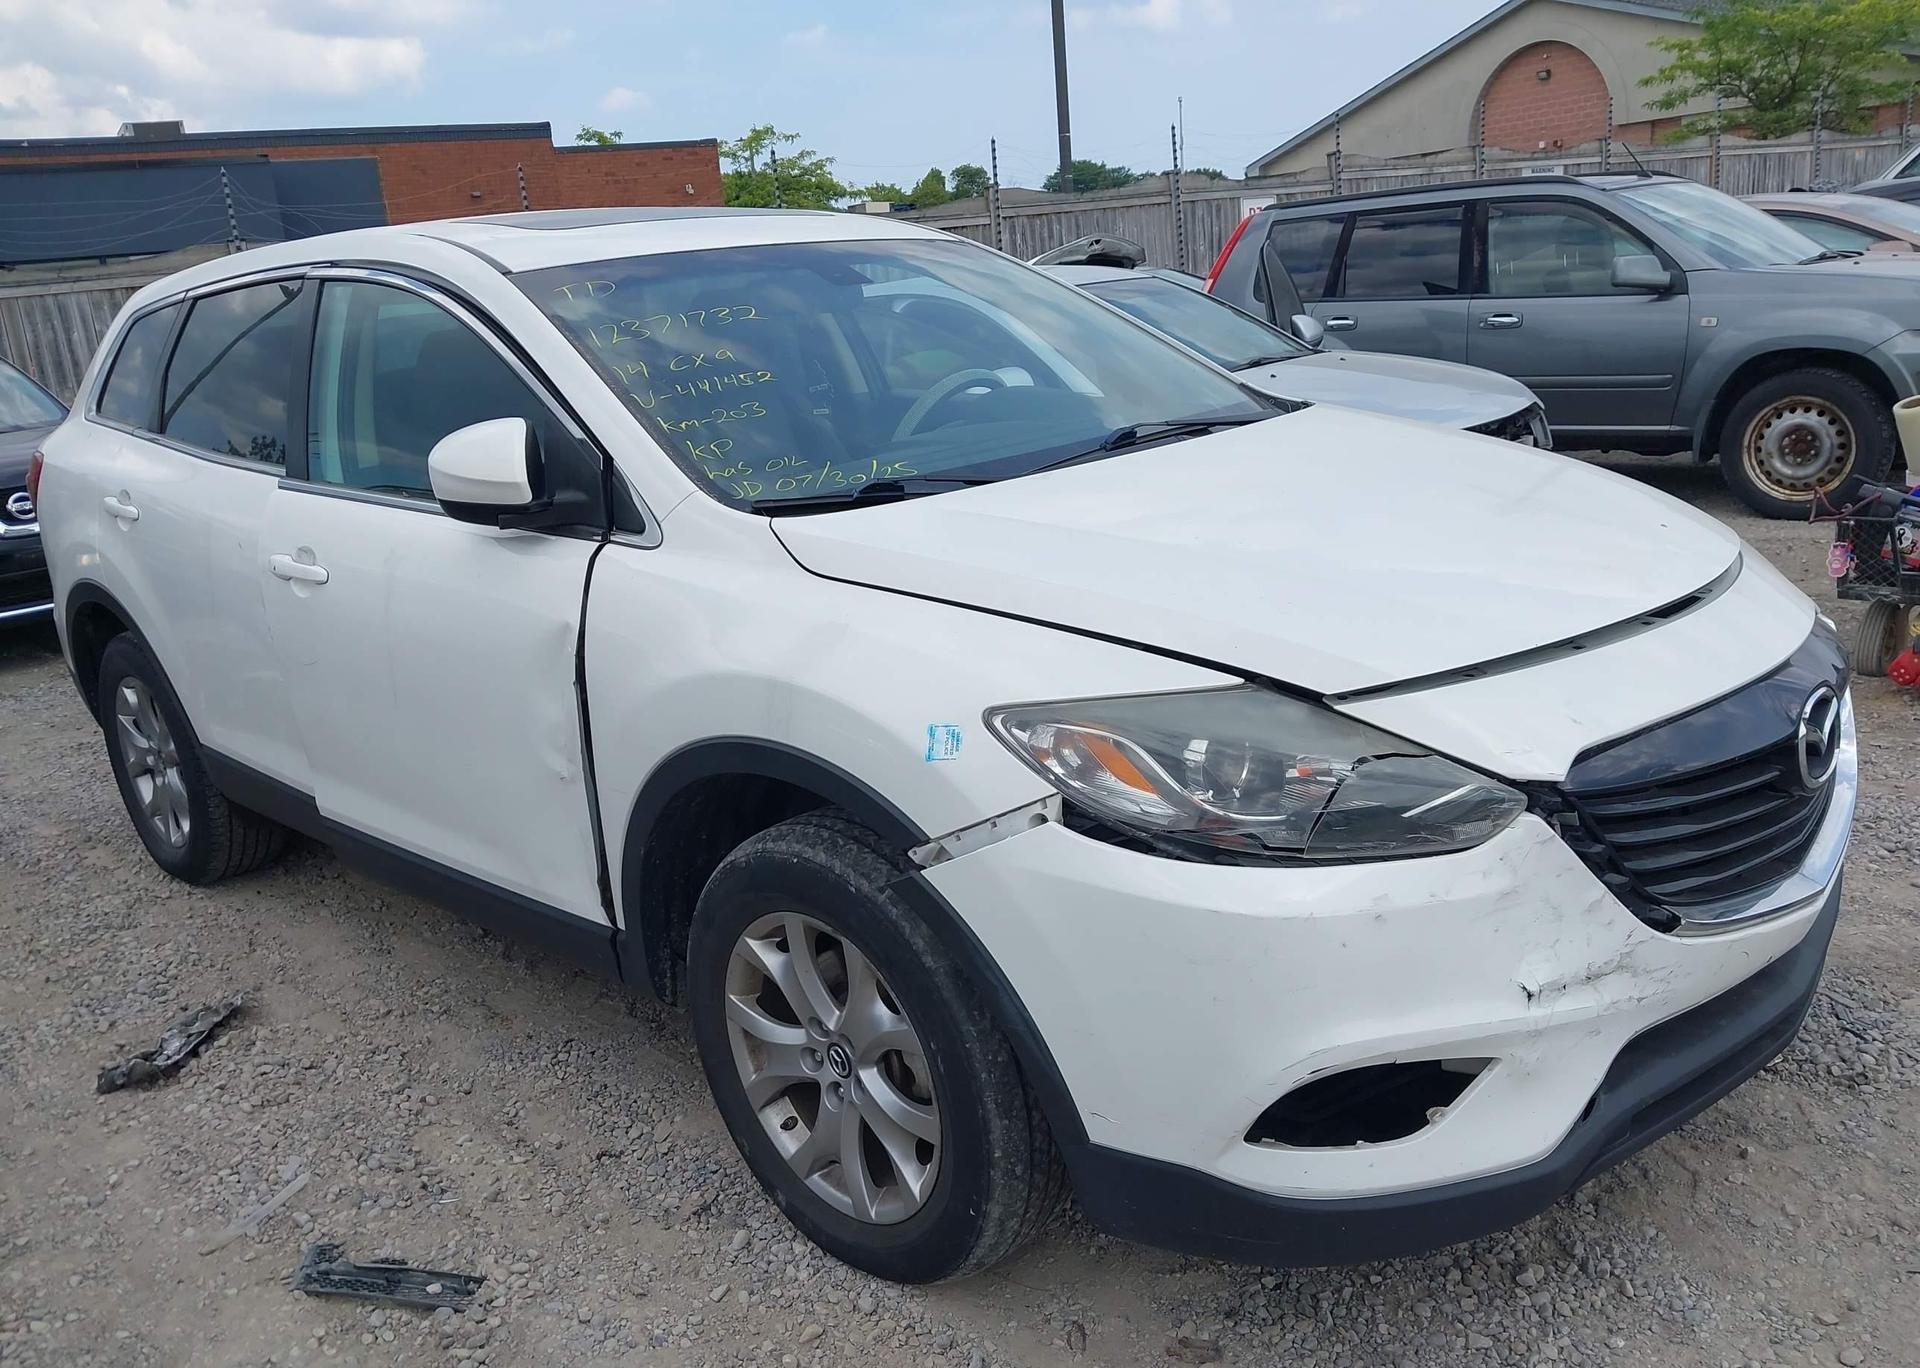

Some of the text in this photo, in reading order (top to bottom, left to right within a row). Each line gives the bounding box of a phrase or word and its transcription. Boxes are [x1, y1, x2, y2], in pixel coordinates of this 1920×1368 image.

[553, 280, 616, 301] TD
[588, 305, 769, 349] 12371732
[612, 360, 649, 385] 14
[775, 460, 919, 492] 07/30/25
